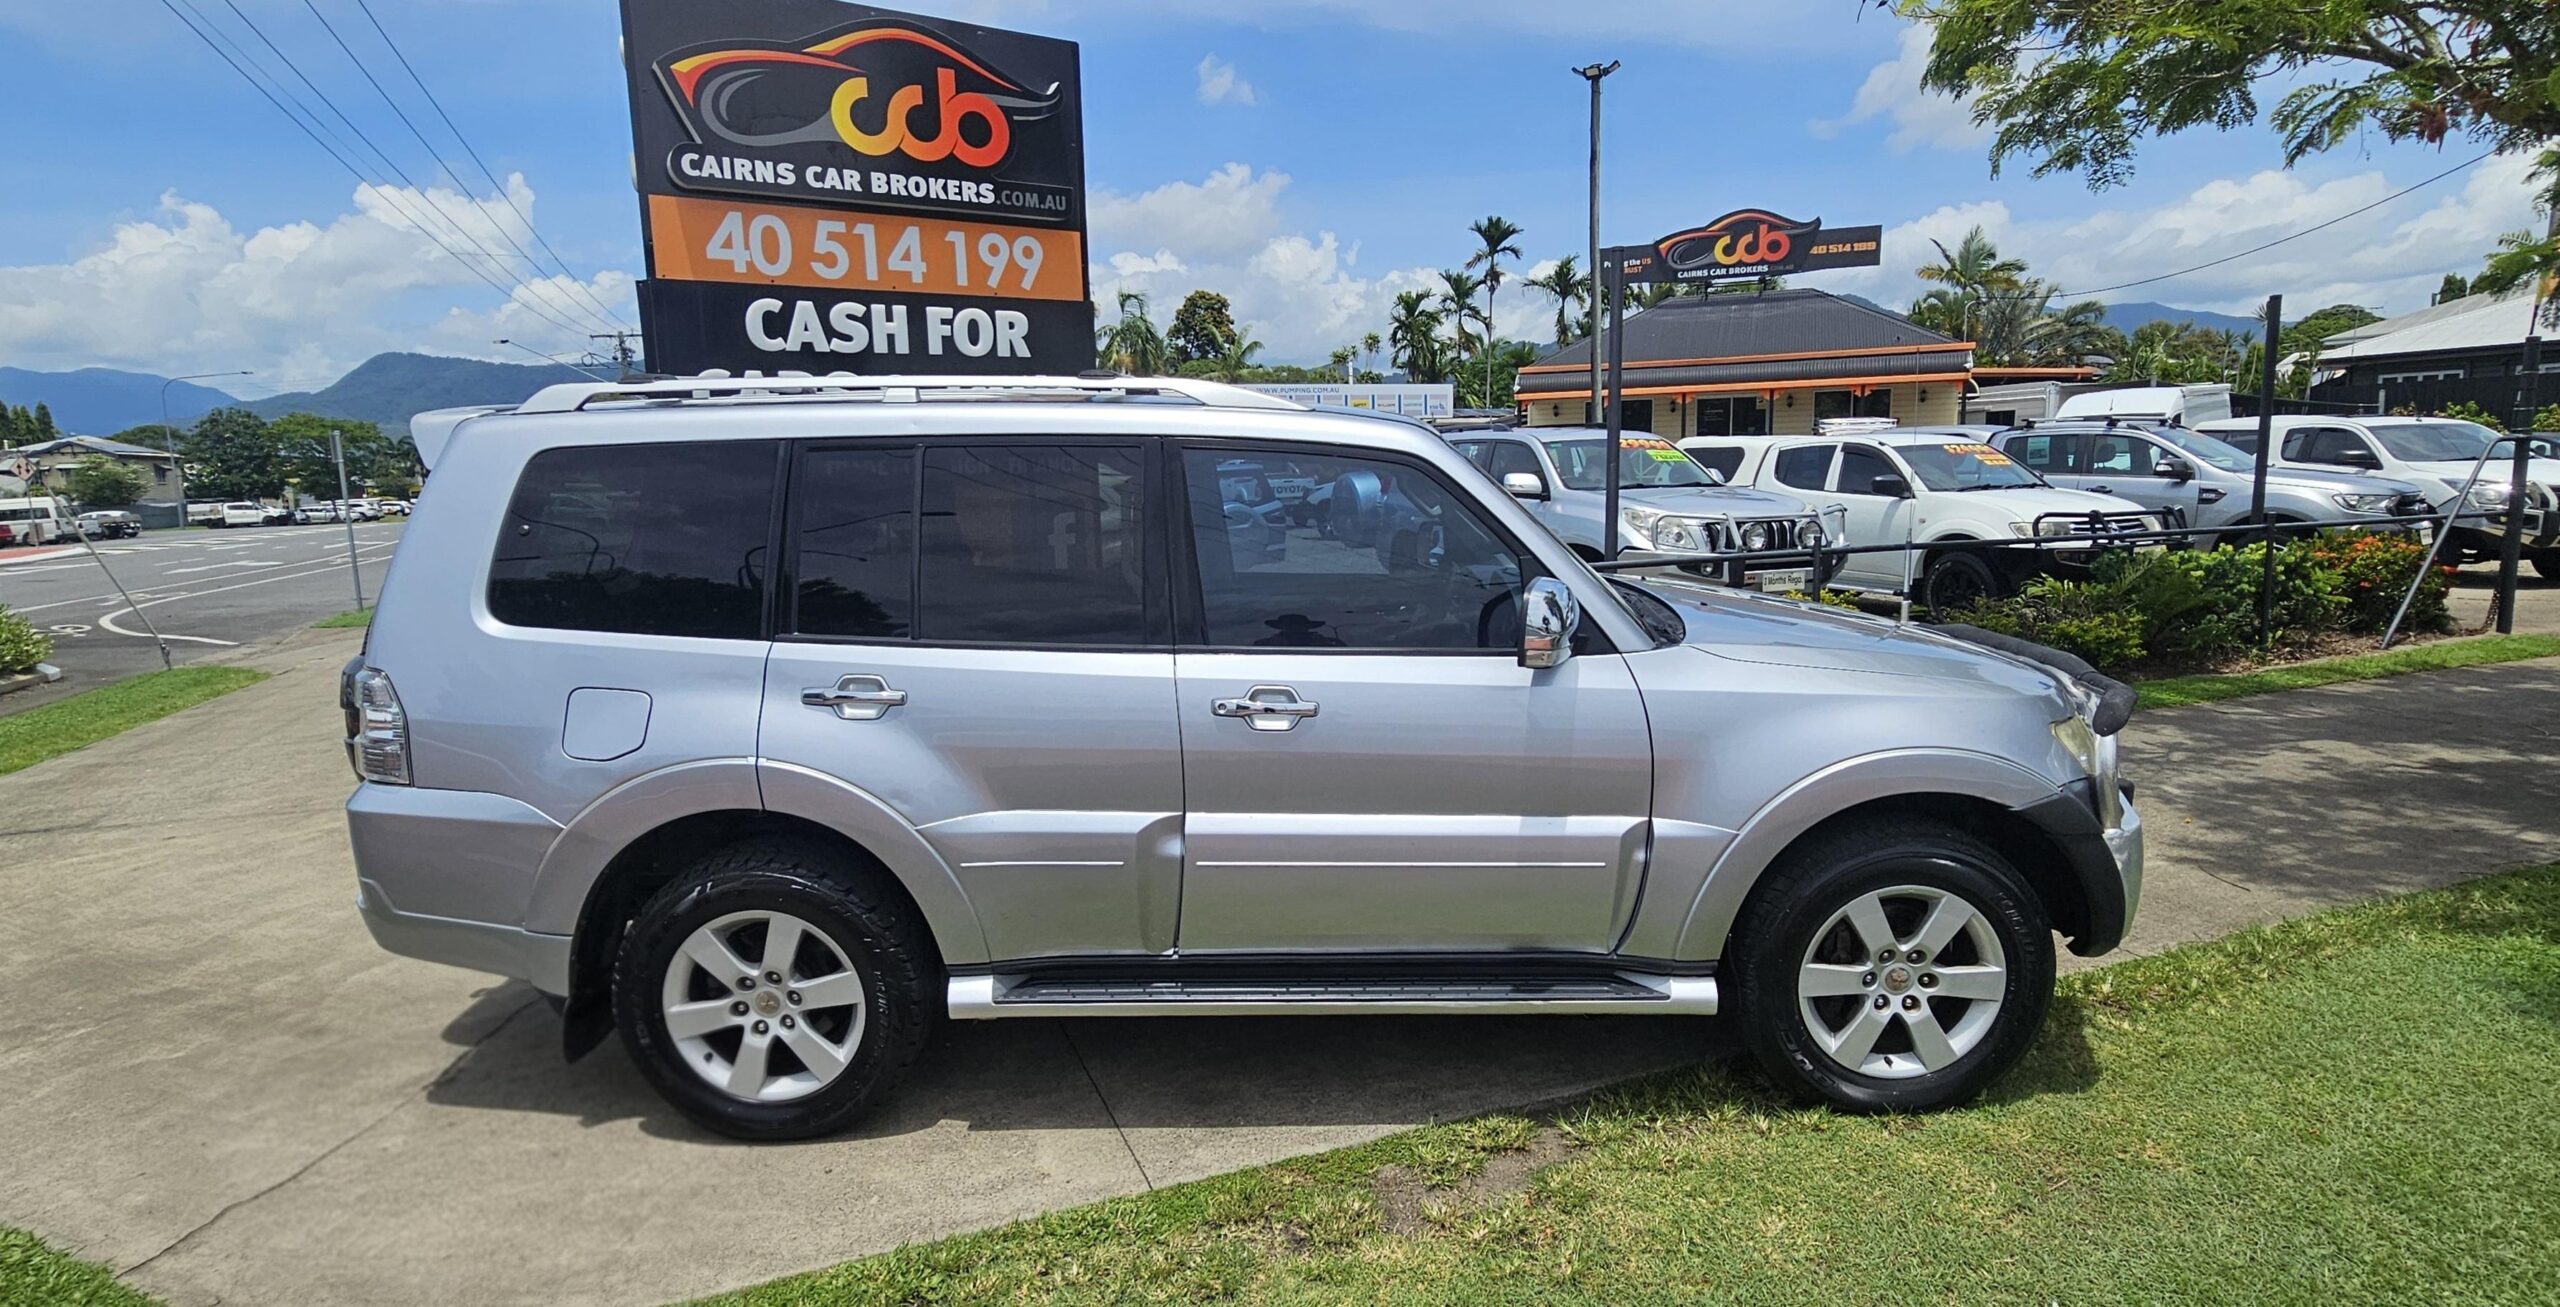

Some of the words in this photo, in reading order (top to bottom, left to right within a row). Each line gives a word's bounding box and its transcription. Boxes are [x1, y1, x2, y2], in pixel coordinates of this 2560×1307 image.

[680, 153, 797, 186] CAIRNS
[805, 166, 863, 193] CAR
[706, 211, 792, 277] 40
[810, 220, 927, 284] 514
[944, 230, 1043, 291] 199
[1809, 245, 1827, 255] 40
[1828, 243, 1851, 253] 514
[1677, 268, 1708, 279] CAIRNS
[1710, 266, 1727, 276] CAR
[745, 298, 910, 355] CASH
[925, 305, 1032, 358] FOR
